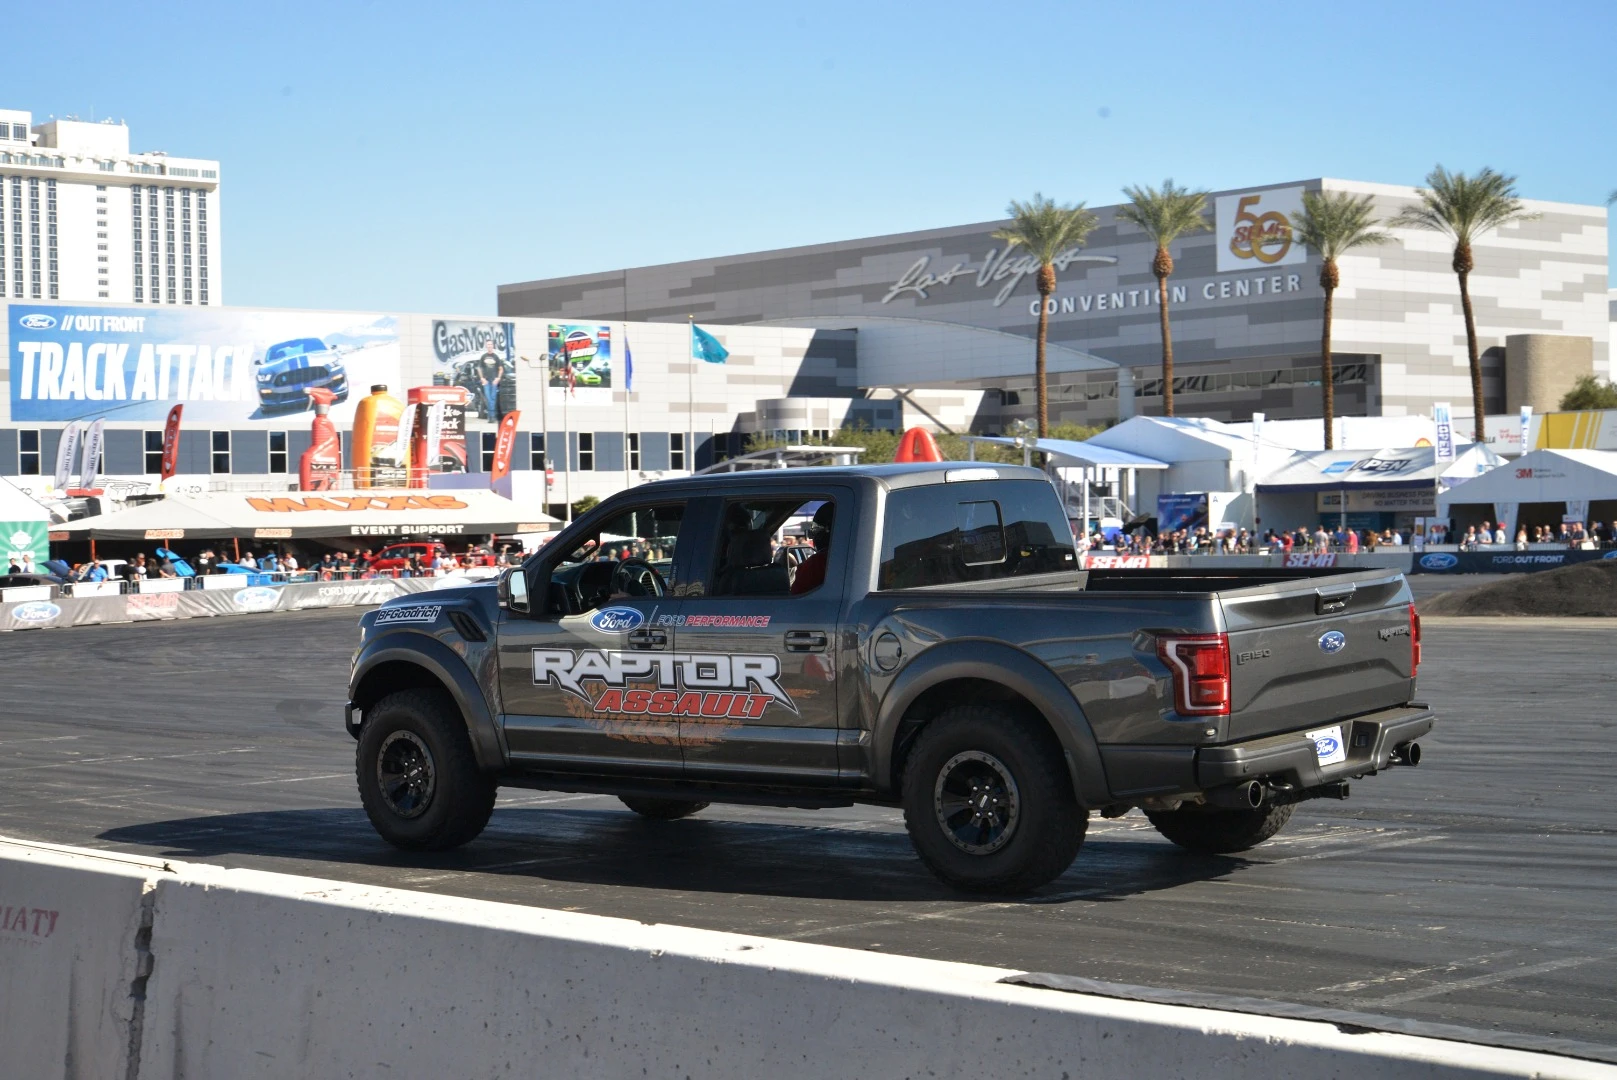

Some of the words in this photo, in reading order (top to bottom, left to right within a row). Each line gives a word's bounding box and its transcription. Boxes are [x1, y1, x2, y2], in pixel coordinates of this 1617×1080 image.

[882, 256, 977, 303] Las
[976, 246, 1118, 306] Vegas
[1029, 286, 1187, 317] CONVENTION
[1203, 275, 1300, 299] CENTER
[75, 315, 103, 331] OUT
[103, 316, 146, 332] FRONT
[18, 341, 129, 400] TRACK
[131, 343, 254, 401] ATTACK
[1438, 424, 1451, 457] OPEN
[1354, 459, 1410, 472] OPEN
[1516, 468, 1532, 479] 3M
[245, 496, 468, 512] MAXXIS
[351, 526, 397, 535] EVENT
[401, 525, 464, 534] SUPPORT
[1091, 556, 1147, 568] SEMA
[1286, 553, 1335, 567] SEMA
[1515, 555, 1533, 563] OUT
[1534, 554, 1564, 563] FRONT
[319, 586, 343, 596] FORD
[378, 607, 440, 620] BFGoodrich
[657, 615, 685, 627] FORD
[685, 615, 771, 628] PERFORMANCE
[532, 648, 799, 715] RAPTOR
[594, 689, 776, 719] ASSAULT
